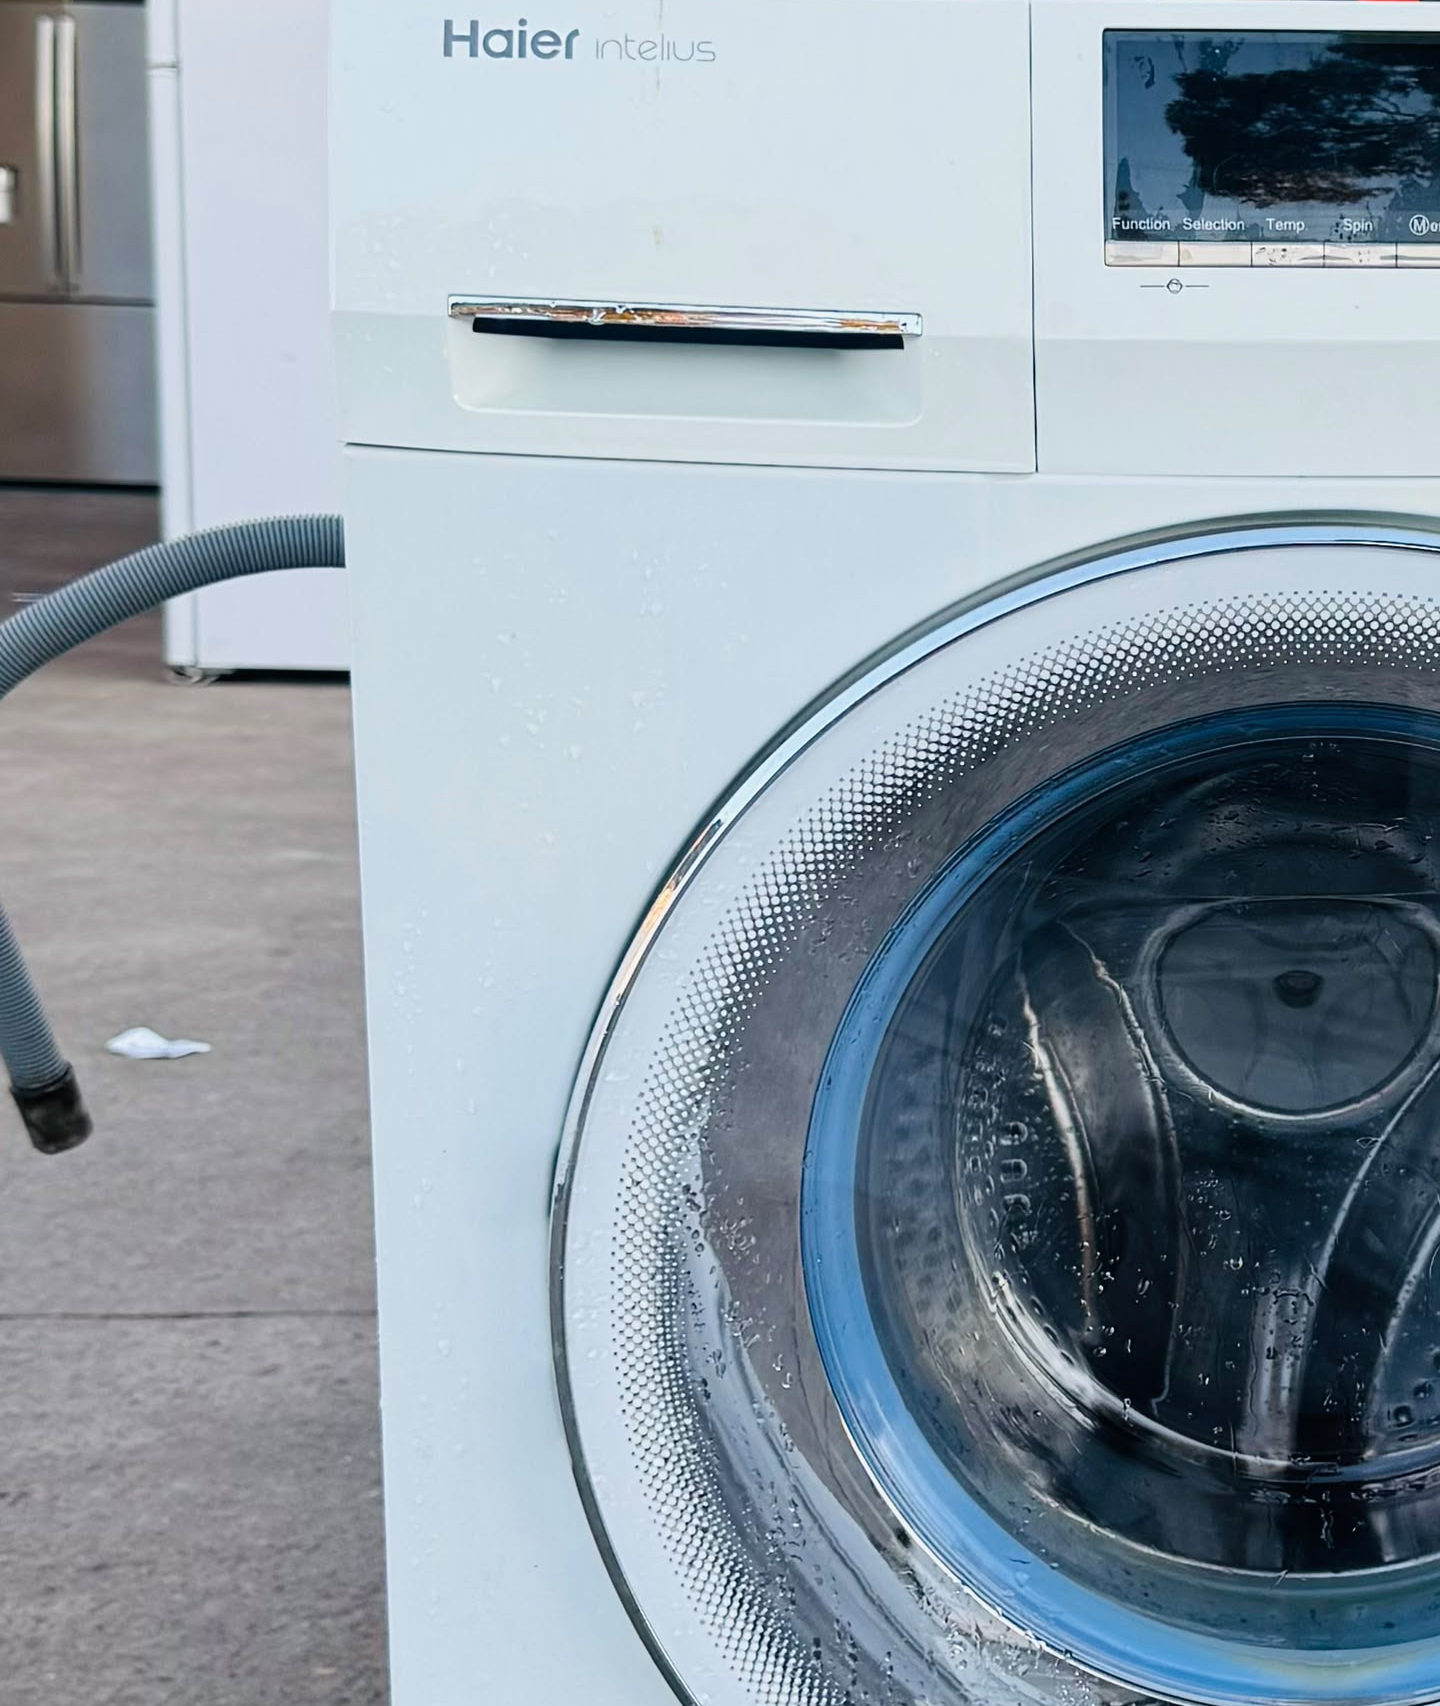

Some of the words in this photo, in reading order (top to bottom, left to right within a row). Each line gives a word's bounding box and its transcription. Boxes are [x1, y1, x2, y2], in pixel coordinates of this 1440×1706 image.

[442, 18, 580, 60] Haier
[595, 33, 716, 62] intelius
[1112, 217, 1171, 230] Function
[1182, 217, 1245, 231] Selection
[1343, 219, 1373, 234] Spin
